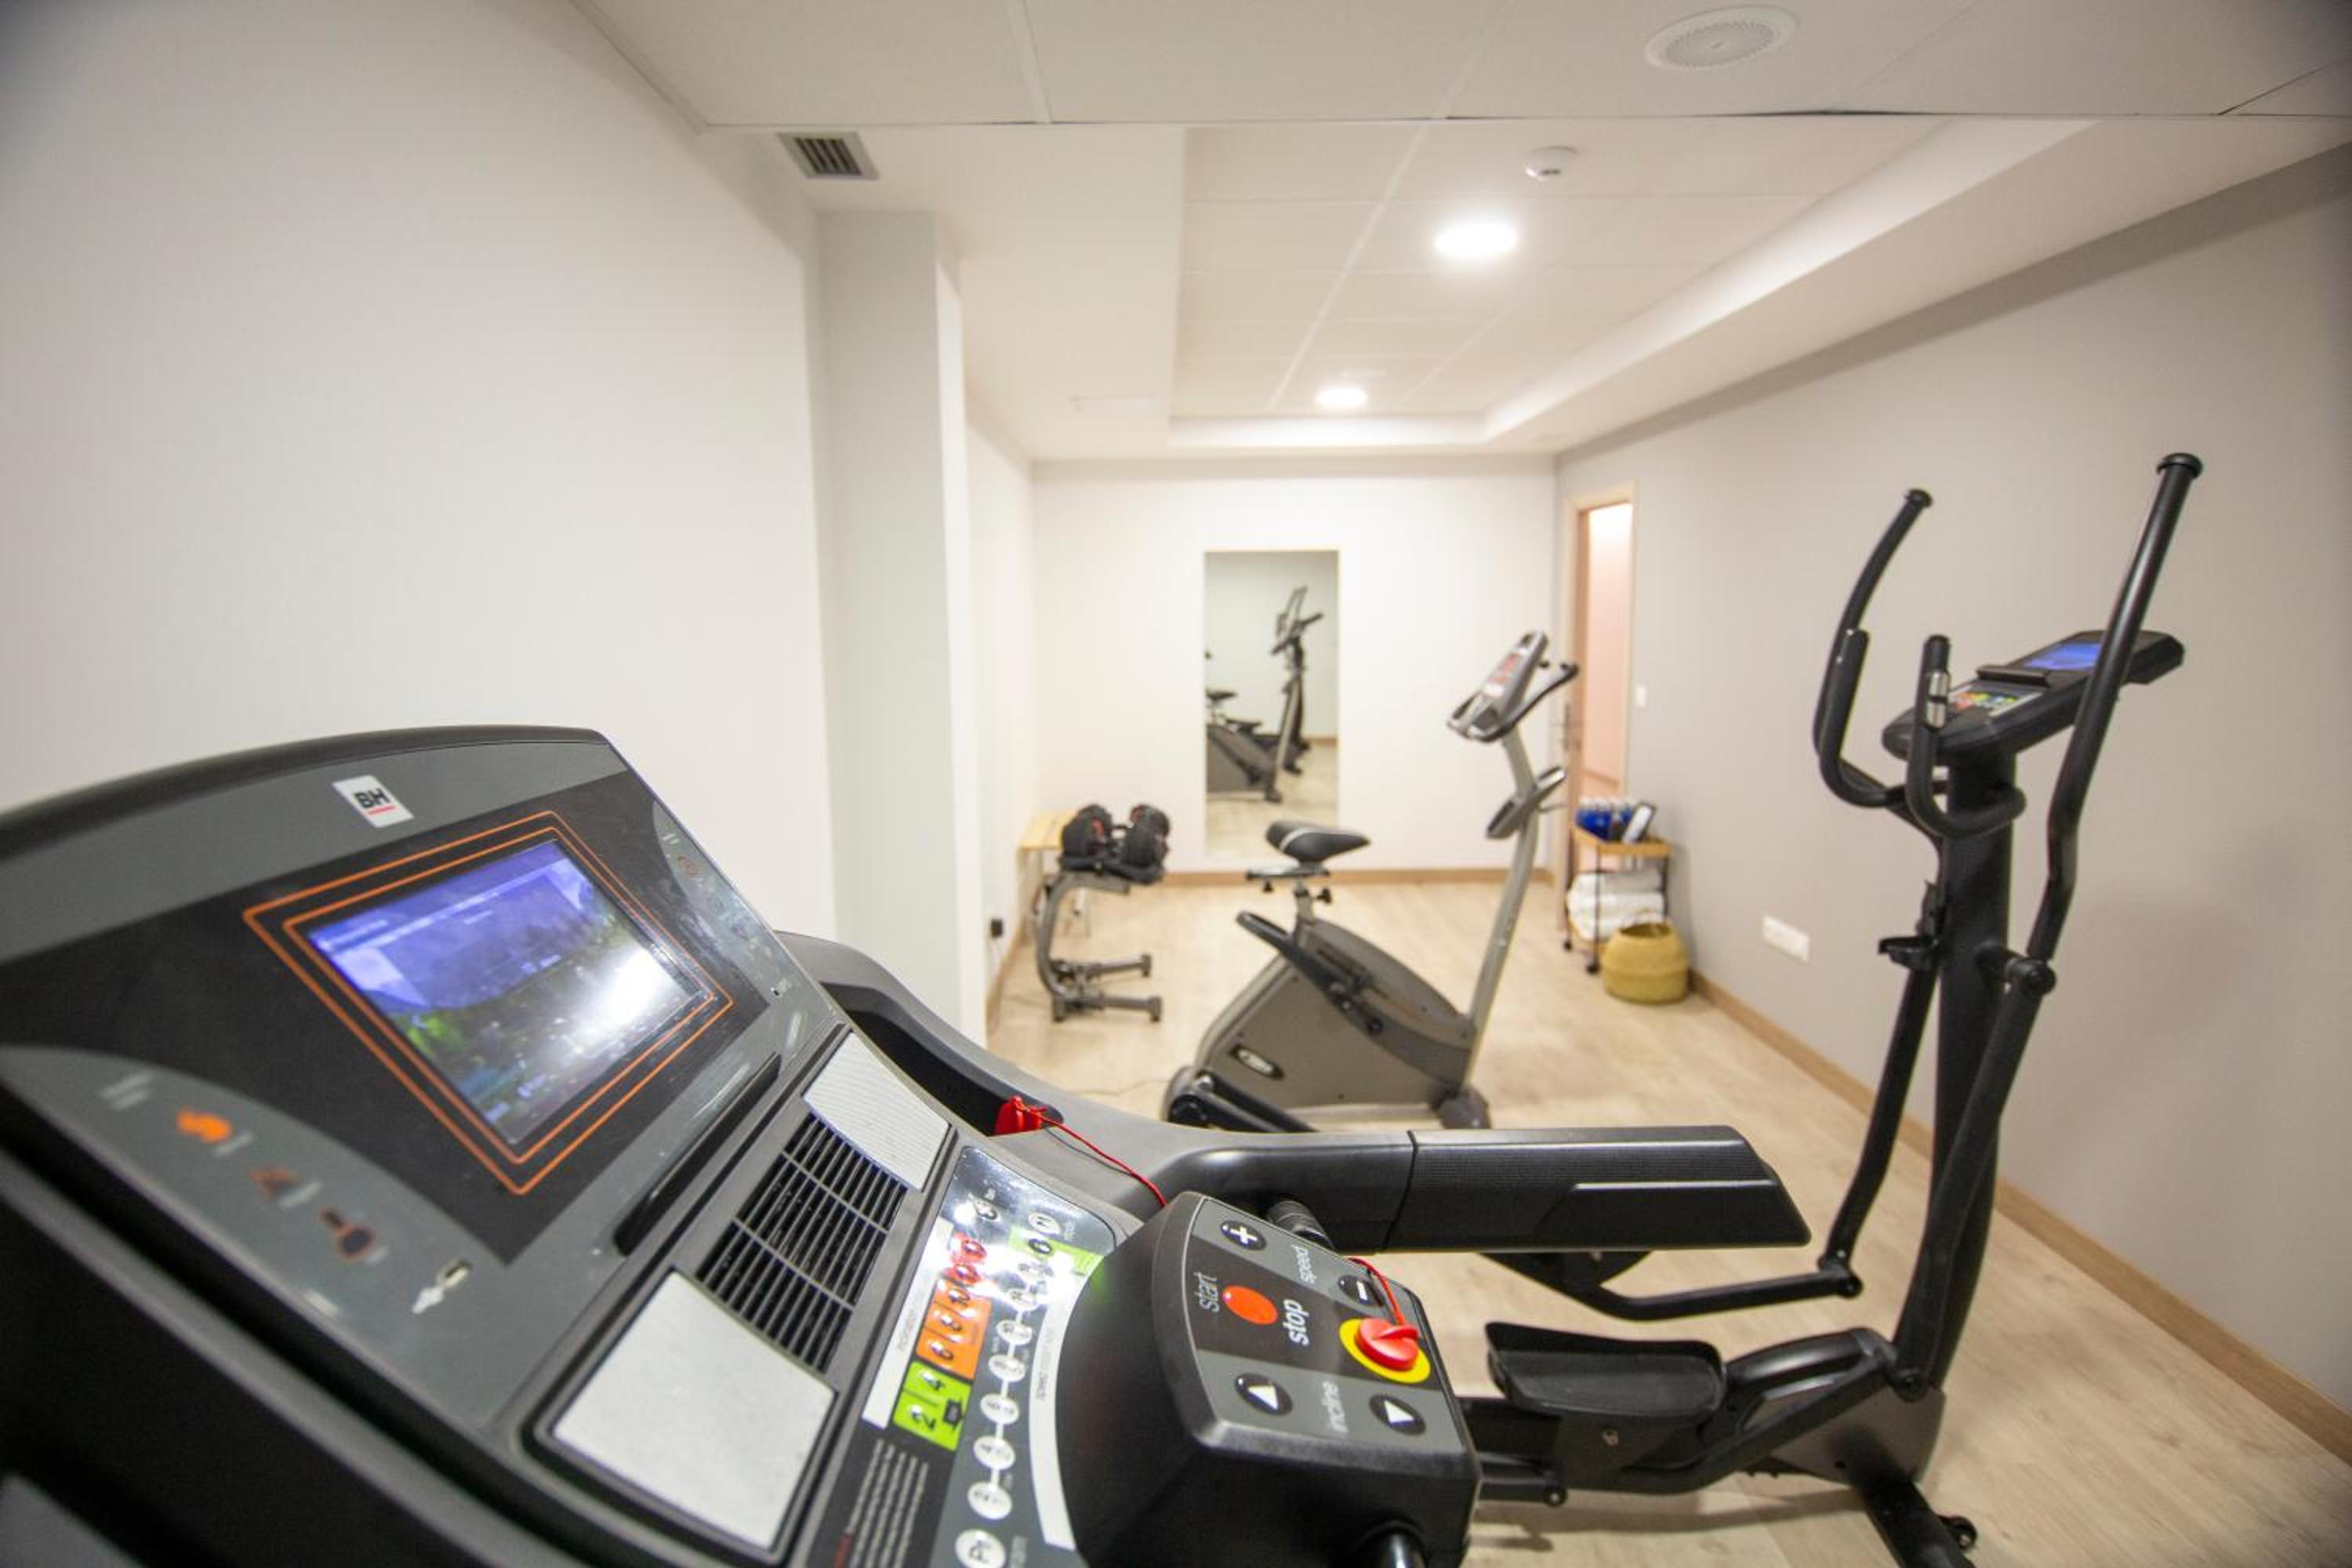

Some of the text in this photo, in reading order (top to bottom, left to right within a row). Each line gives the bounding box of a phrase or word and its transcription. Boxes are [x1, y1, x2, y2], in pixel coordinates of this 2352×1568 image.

[354, 788, 391, 808] BH
[1193, 1271, 1221, 1313] start
[1282, 1298, 1309, 1346] stop
